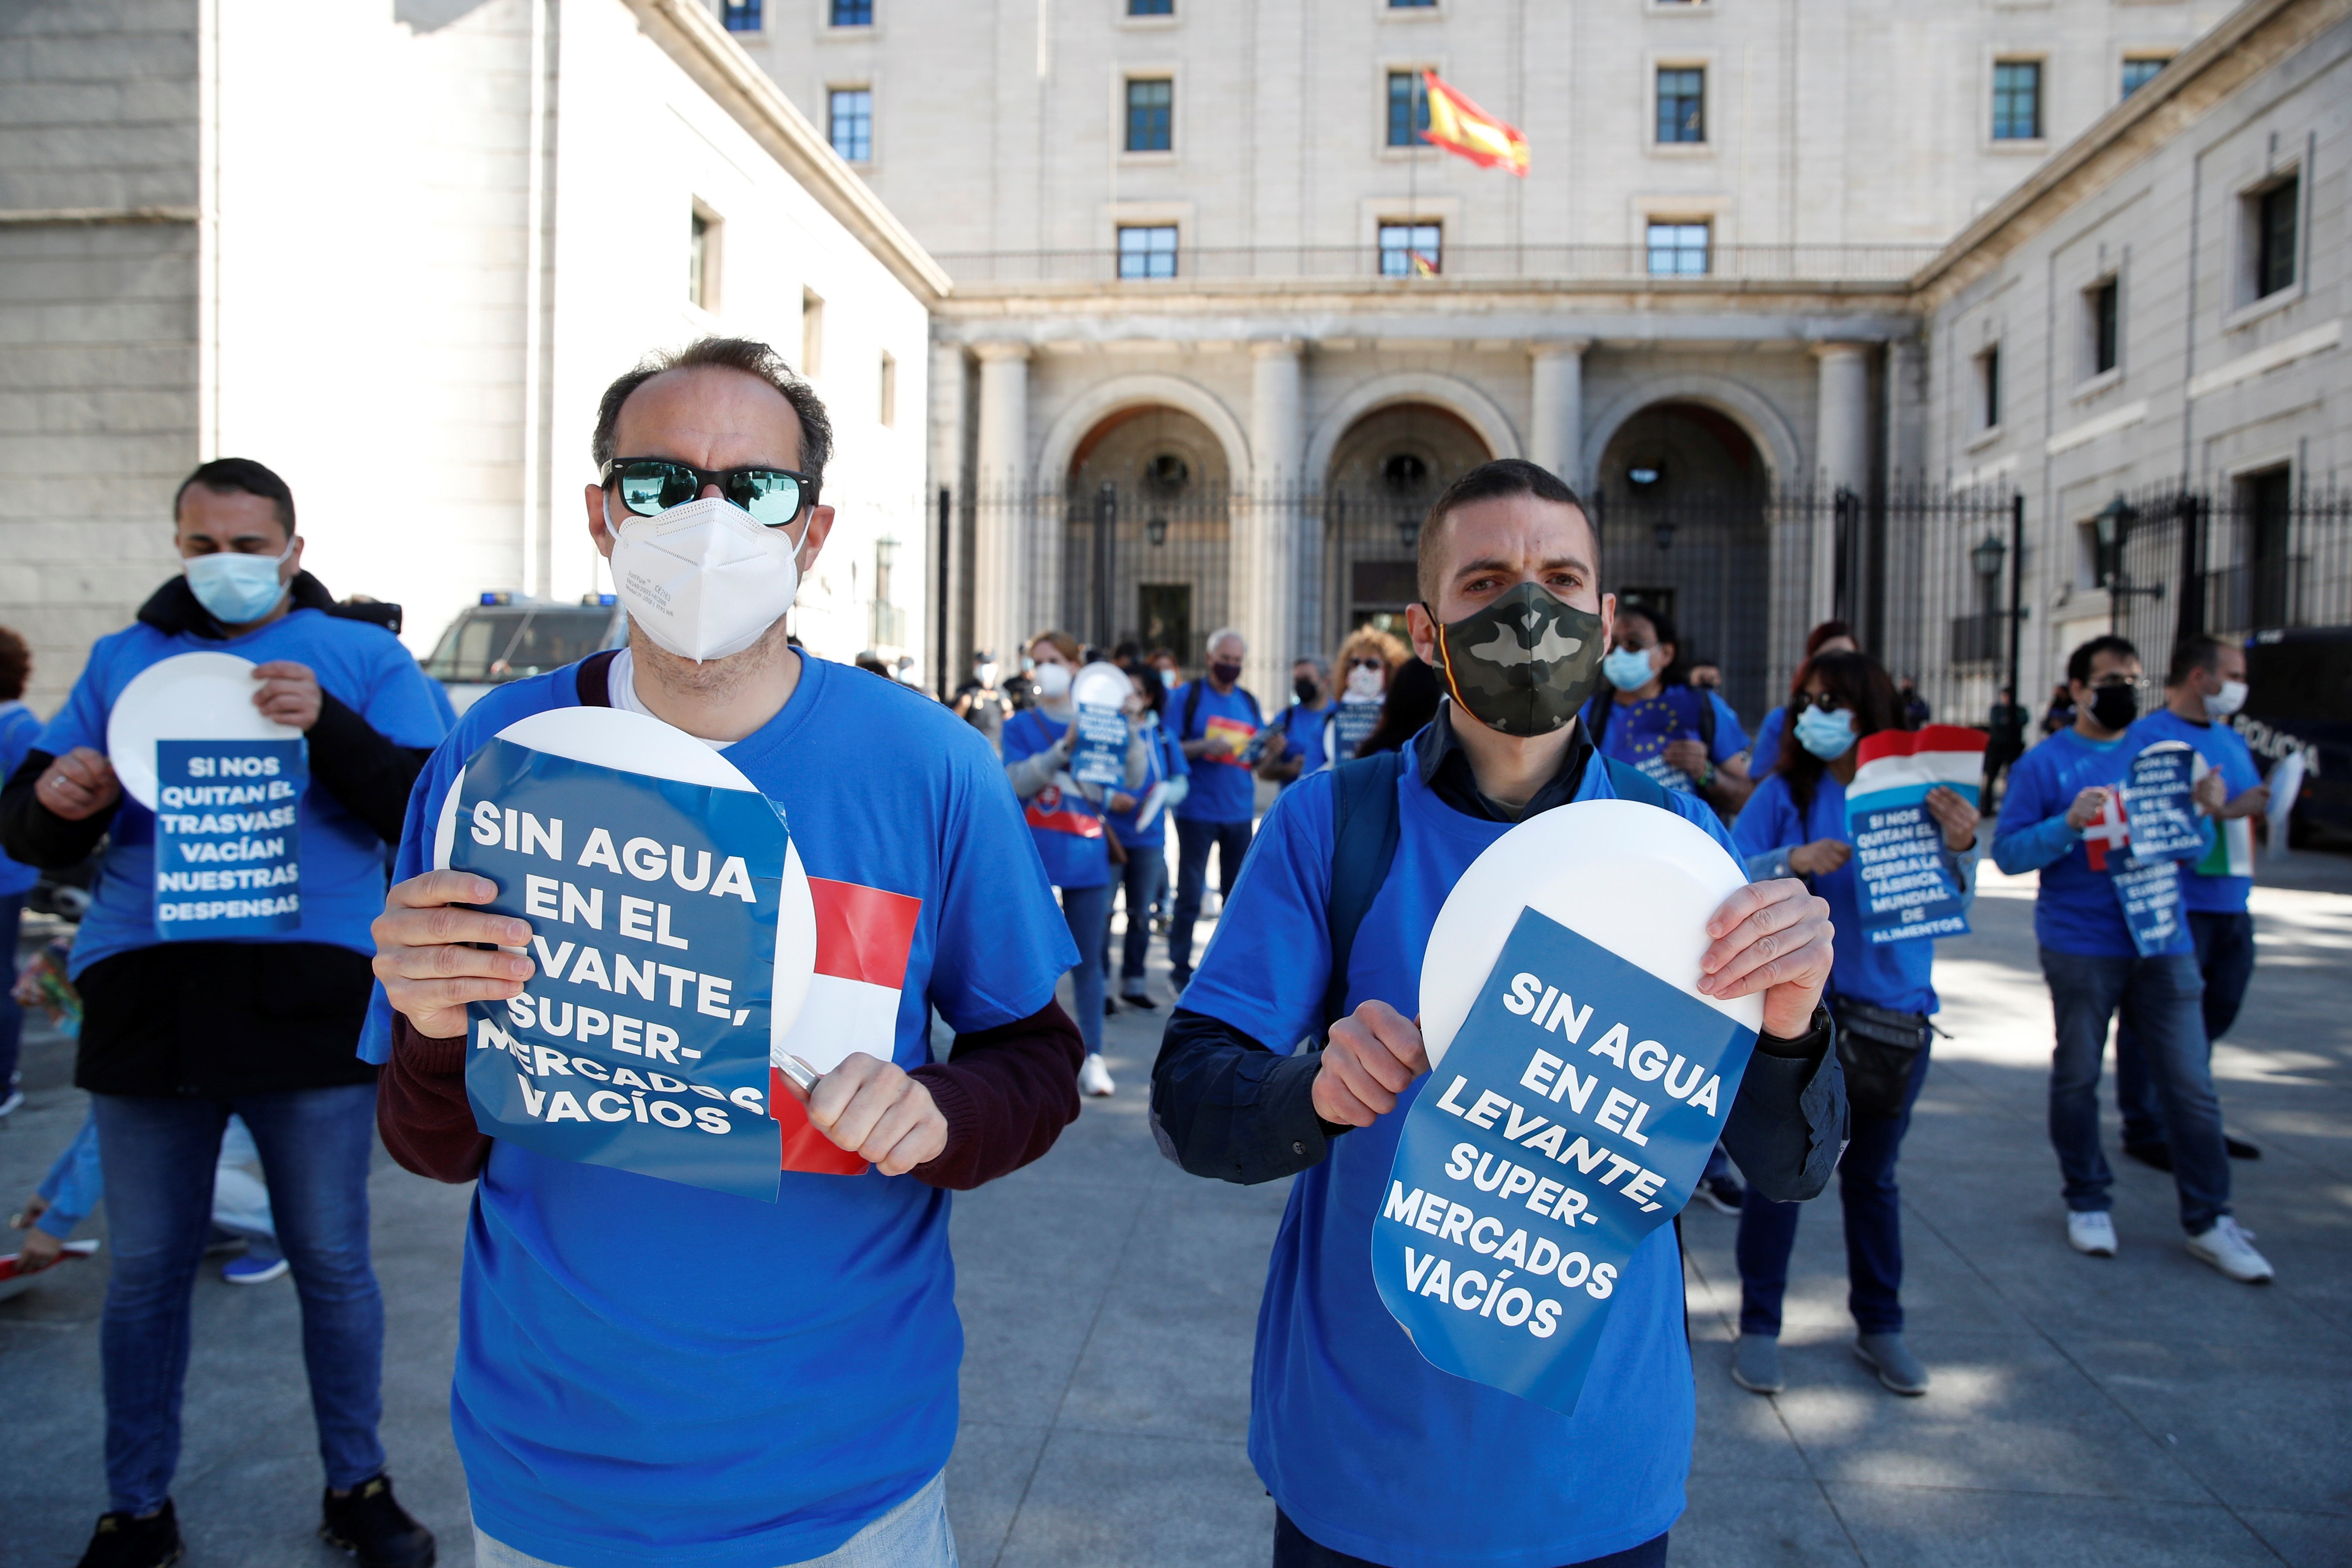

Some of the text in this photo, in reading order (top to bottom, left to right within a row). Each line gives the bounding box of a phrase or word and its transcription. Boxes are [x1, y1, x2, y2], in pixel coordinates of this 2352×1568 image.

[628, 570, 646, 585] JunYue
[161, 780, 295, 809] QUITAN EL
[188, 756, 279, 777] SI NOS
[159, 805, 295, 834] TRASVASE
[179, 836, 284, 863] VACÍAN
[1857, 826, 1913, 849] QUITAN
[157, 862, 298, 892] NUESTRAS
[471, 801, 756, 903] SIN AGUA
[159, 893, 299, 922] DESPENSAS
[526, 874, 688, 950] EN EL
[1872, 916, 1965, 944] ALIMENTOS
[1901, 906, 1926, 924] DE
[499, 935, 750, 1026] VANTE,
[506, 991, 701, 1065] SUPER-
[1504, 972, 1720, 1117] SIN AGUA
[517, 1073, 731, 1134] VACÍOS
[1519, 1048, 1650, 1147] EN EL
[1436, 1075, 1666, 1212] LEVANTE,
[1445, 1142, 1598, 1227] SUPER-
[1383, 1180, 1618, 1299] MERCADOS
[1405, 1246, 1562, 1338] VACÍOS
